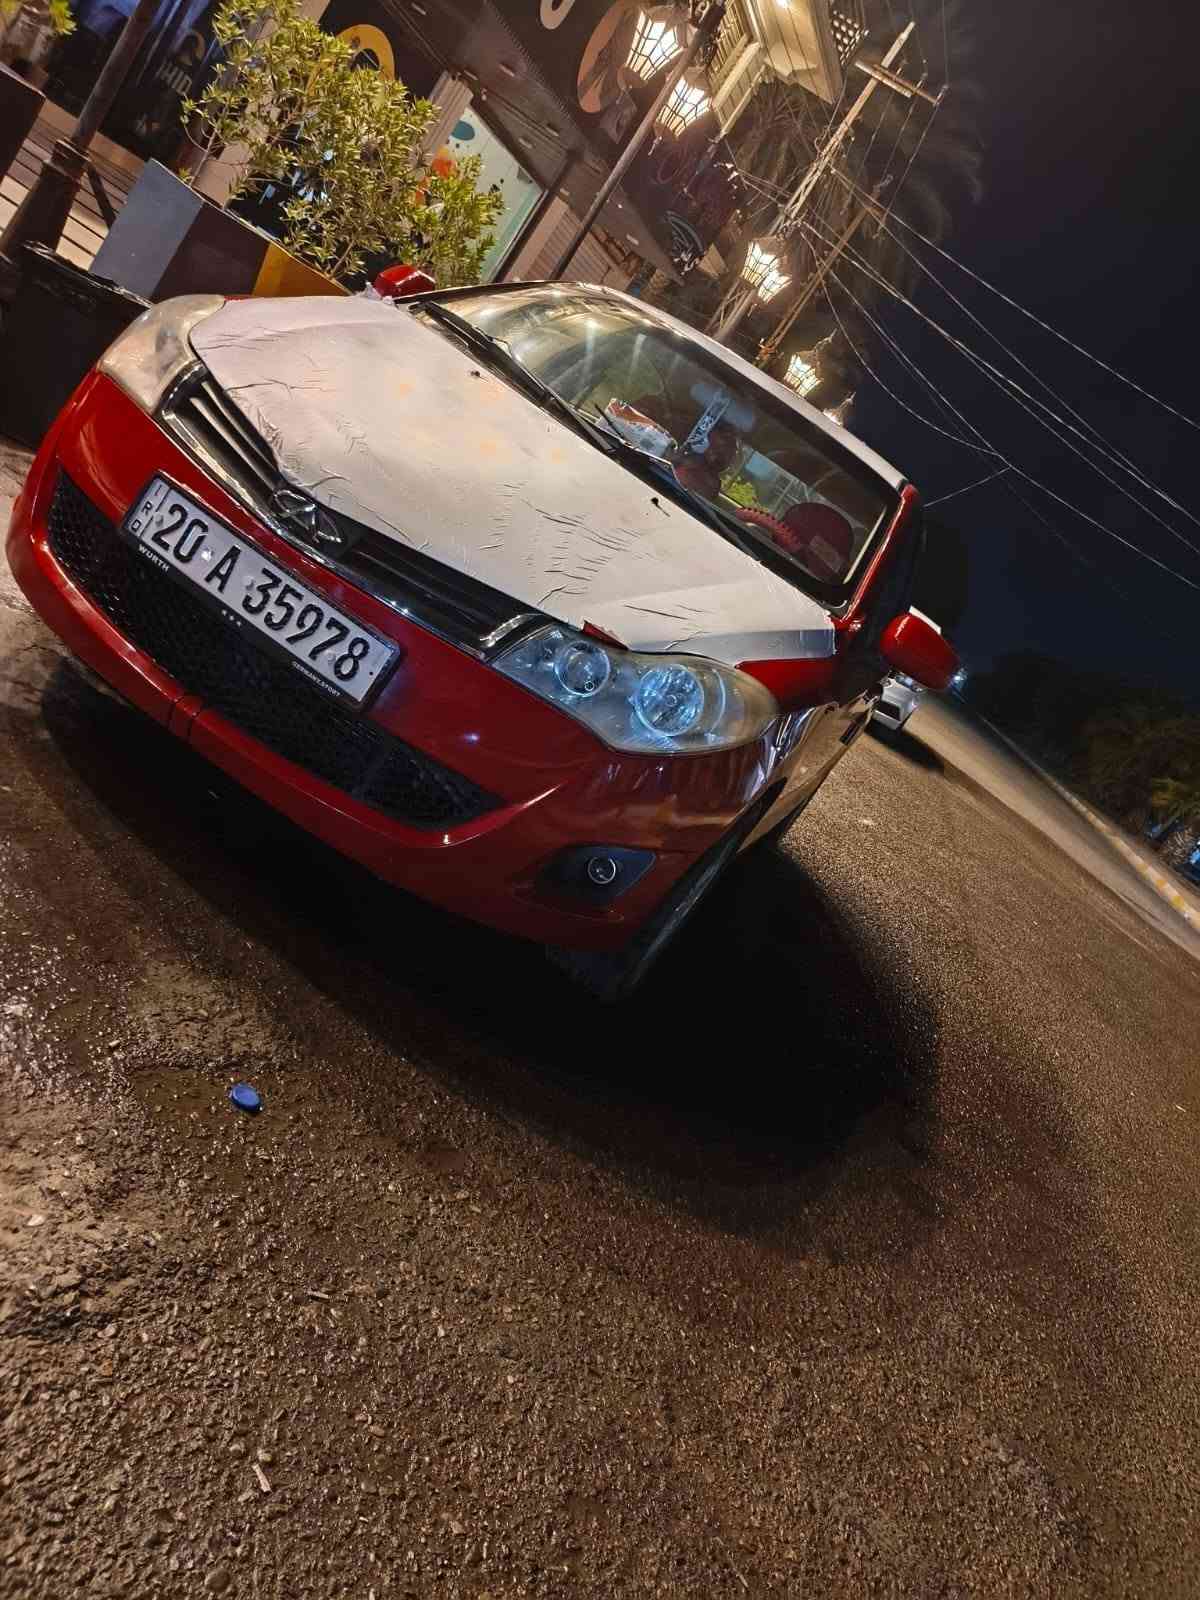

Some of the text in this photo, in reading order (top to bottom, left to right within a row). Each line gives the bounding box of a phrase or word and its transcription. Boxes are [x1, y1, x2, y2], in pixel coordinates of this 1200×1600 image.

[151, 503, 370, 682] 20 A 35978
